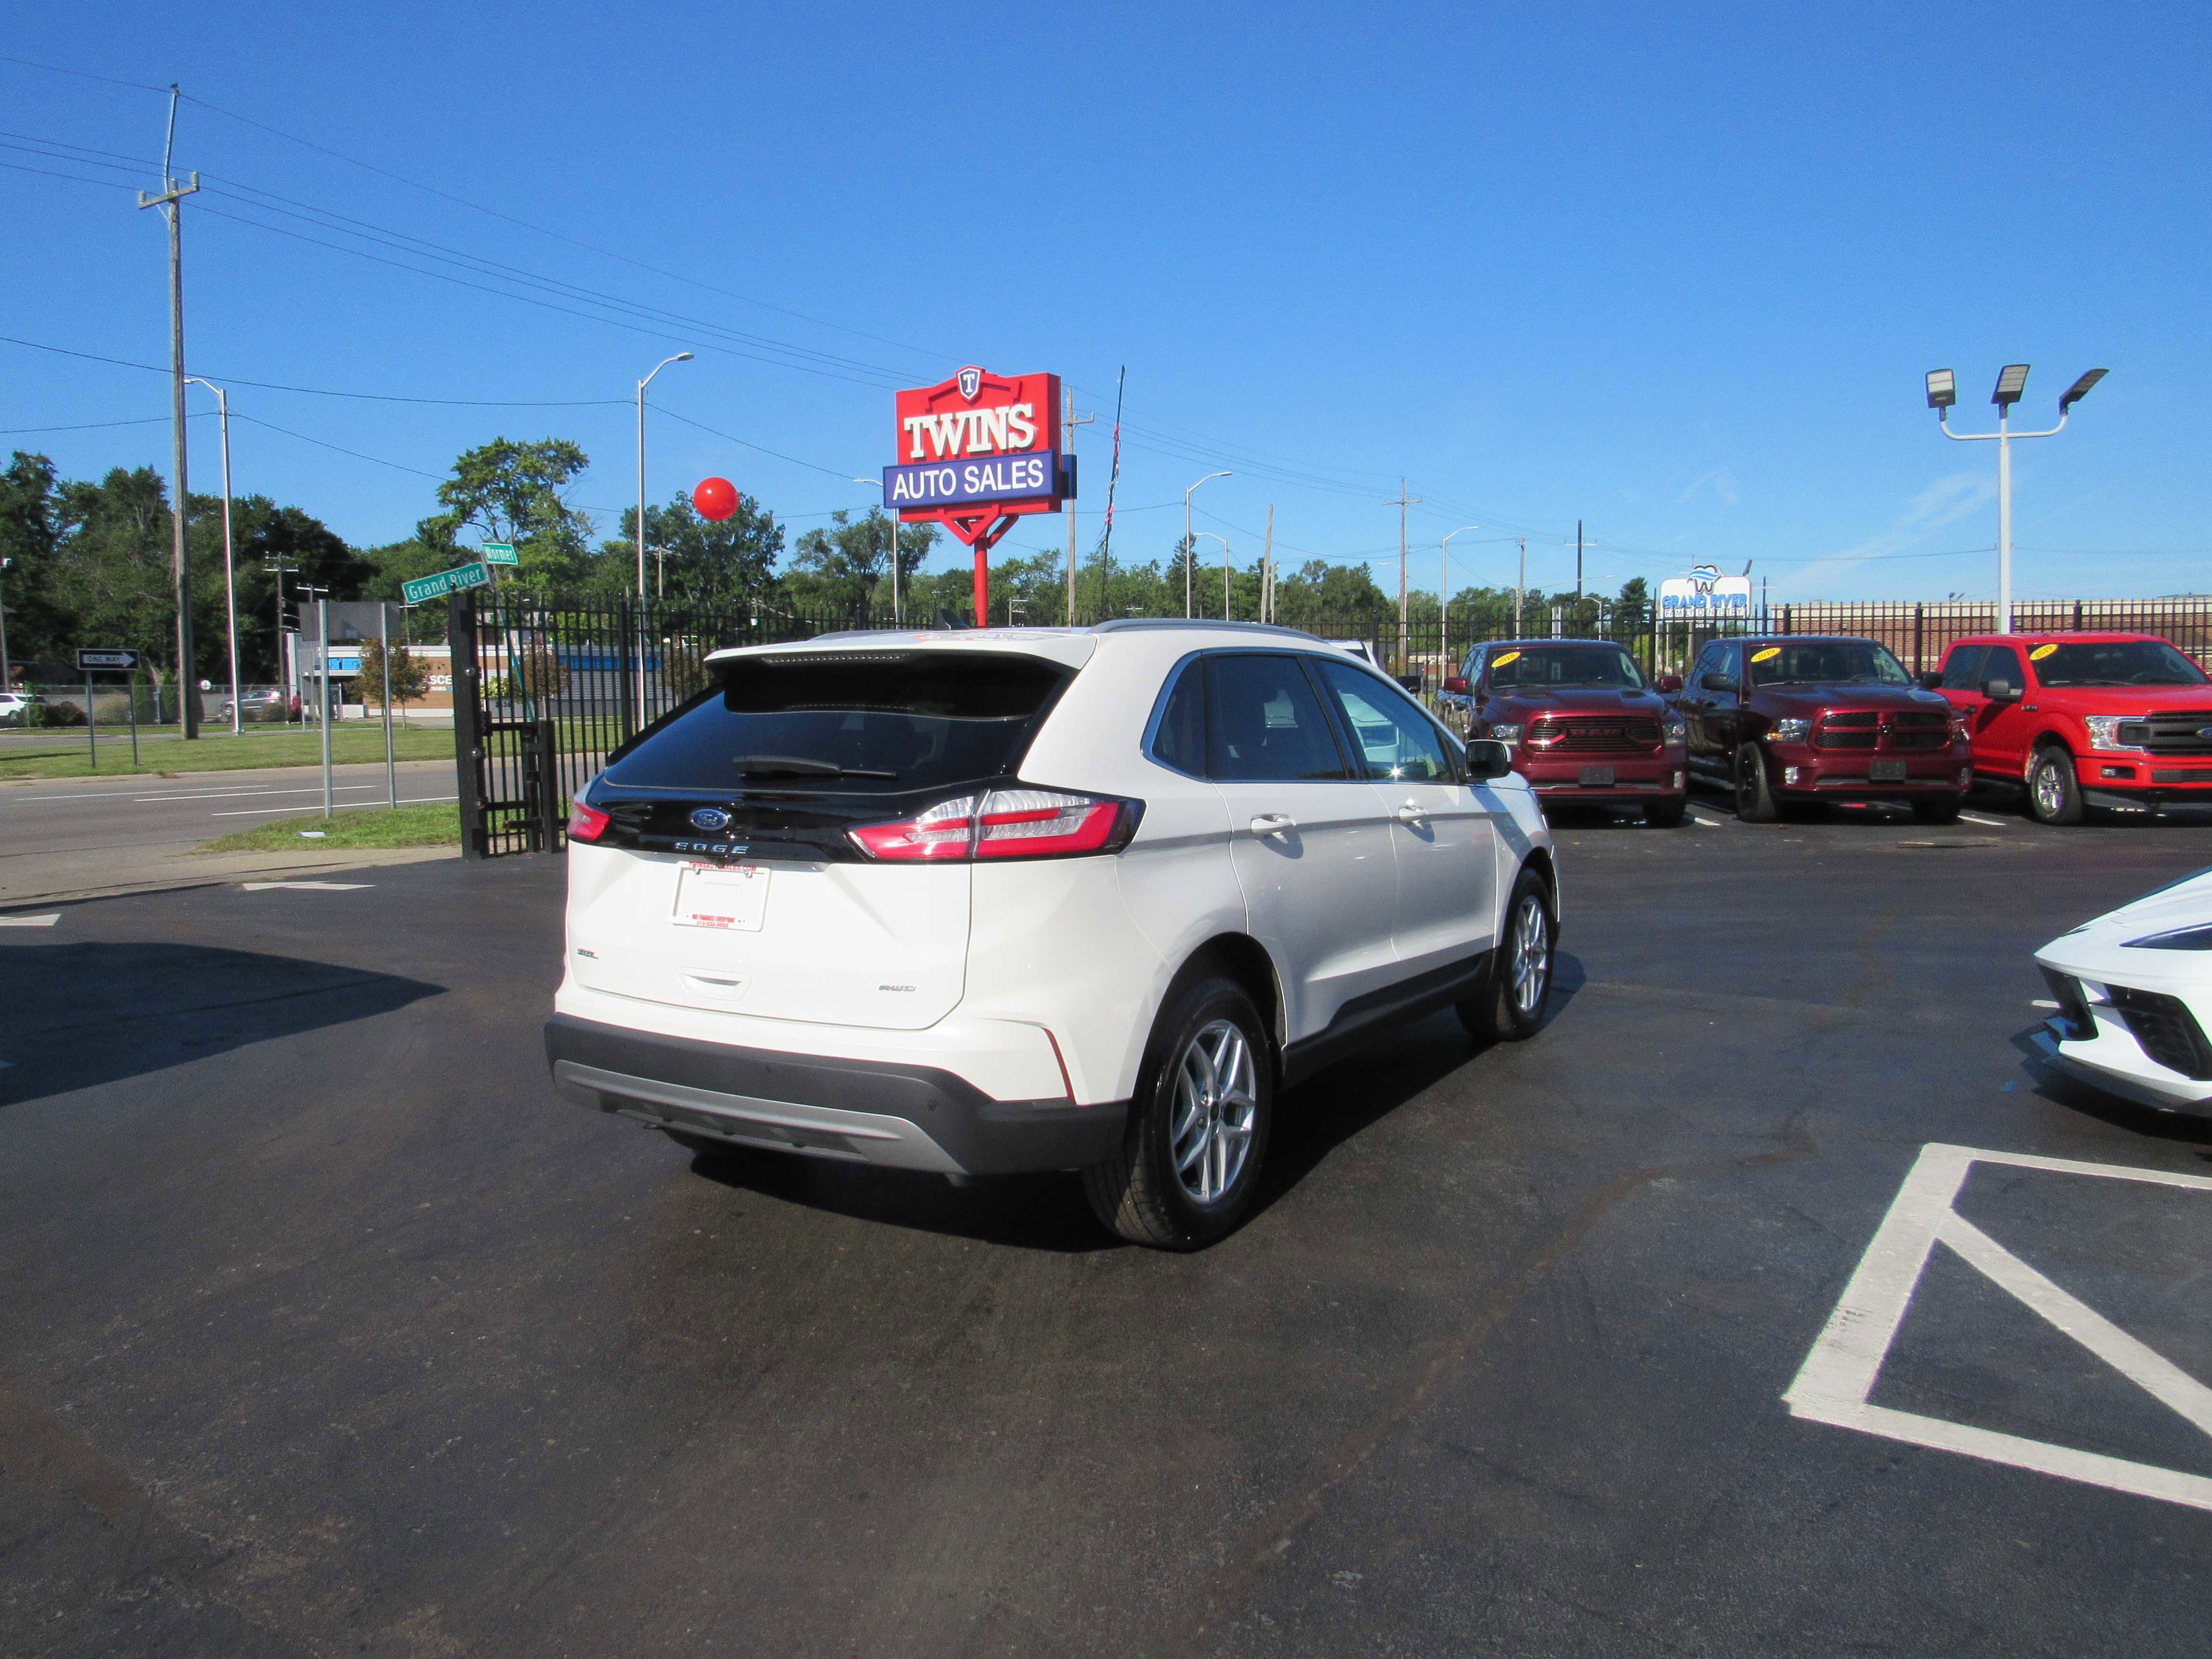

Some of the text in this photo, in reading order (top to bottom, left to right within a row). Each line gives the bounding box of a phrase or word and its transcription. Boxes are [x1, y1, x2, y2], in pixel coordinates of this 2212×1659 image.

[963, 373, 975, 393] T
[904, 403, 1035, 458] TWINS
[893, 459, 1044, 501] AUTO SALES
[484, 547, 514, 560] Wormer
[409, 568, 481, 599] Grand River
[1662, 593, 1747, 609] GRAND RIVER
[1756, 649, 1775, 660] 2019
[2034, 646, 2052, 658] 2019
[1497, 653, 1515, 665] 2018
[674, 842, 749, 854] EDGE
[689, 861, 757, 872] TWINSAUOSALES.COM
